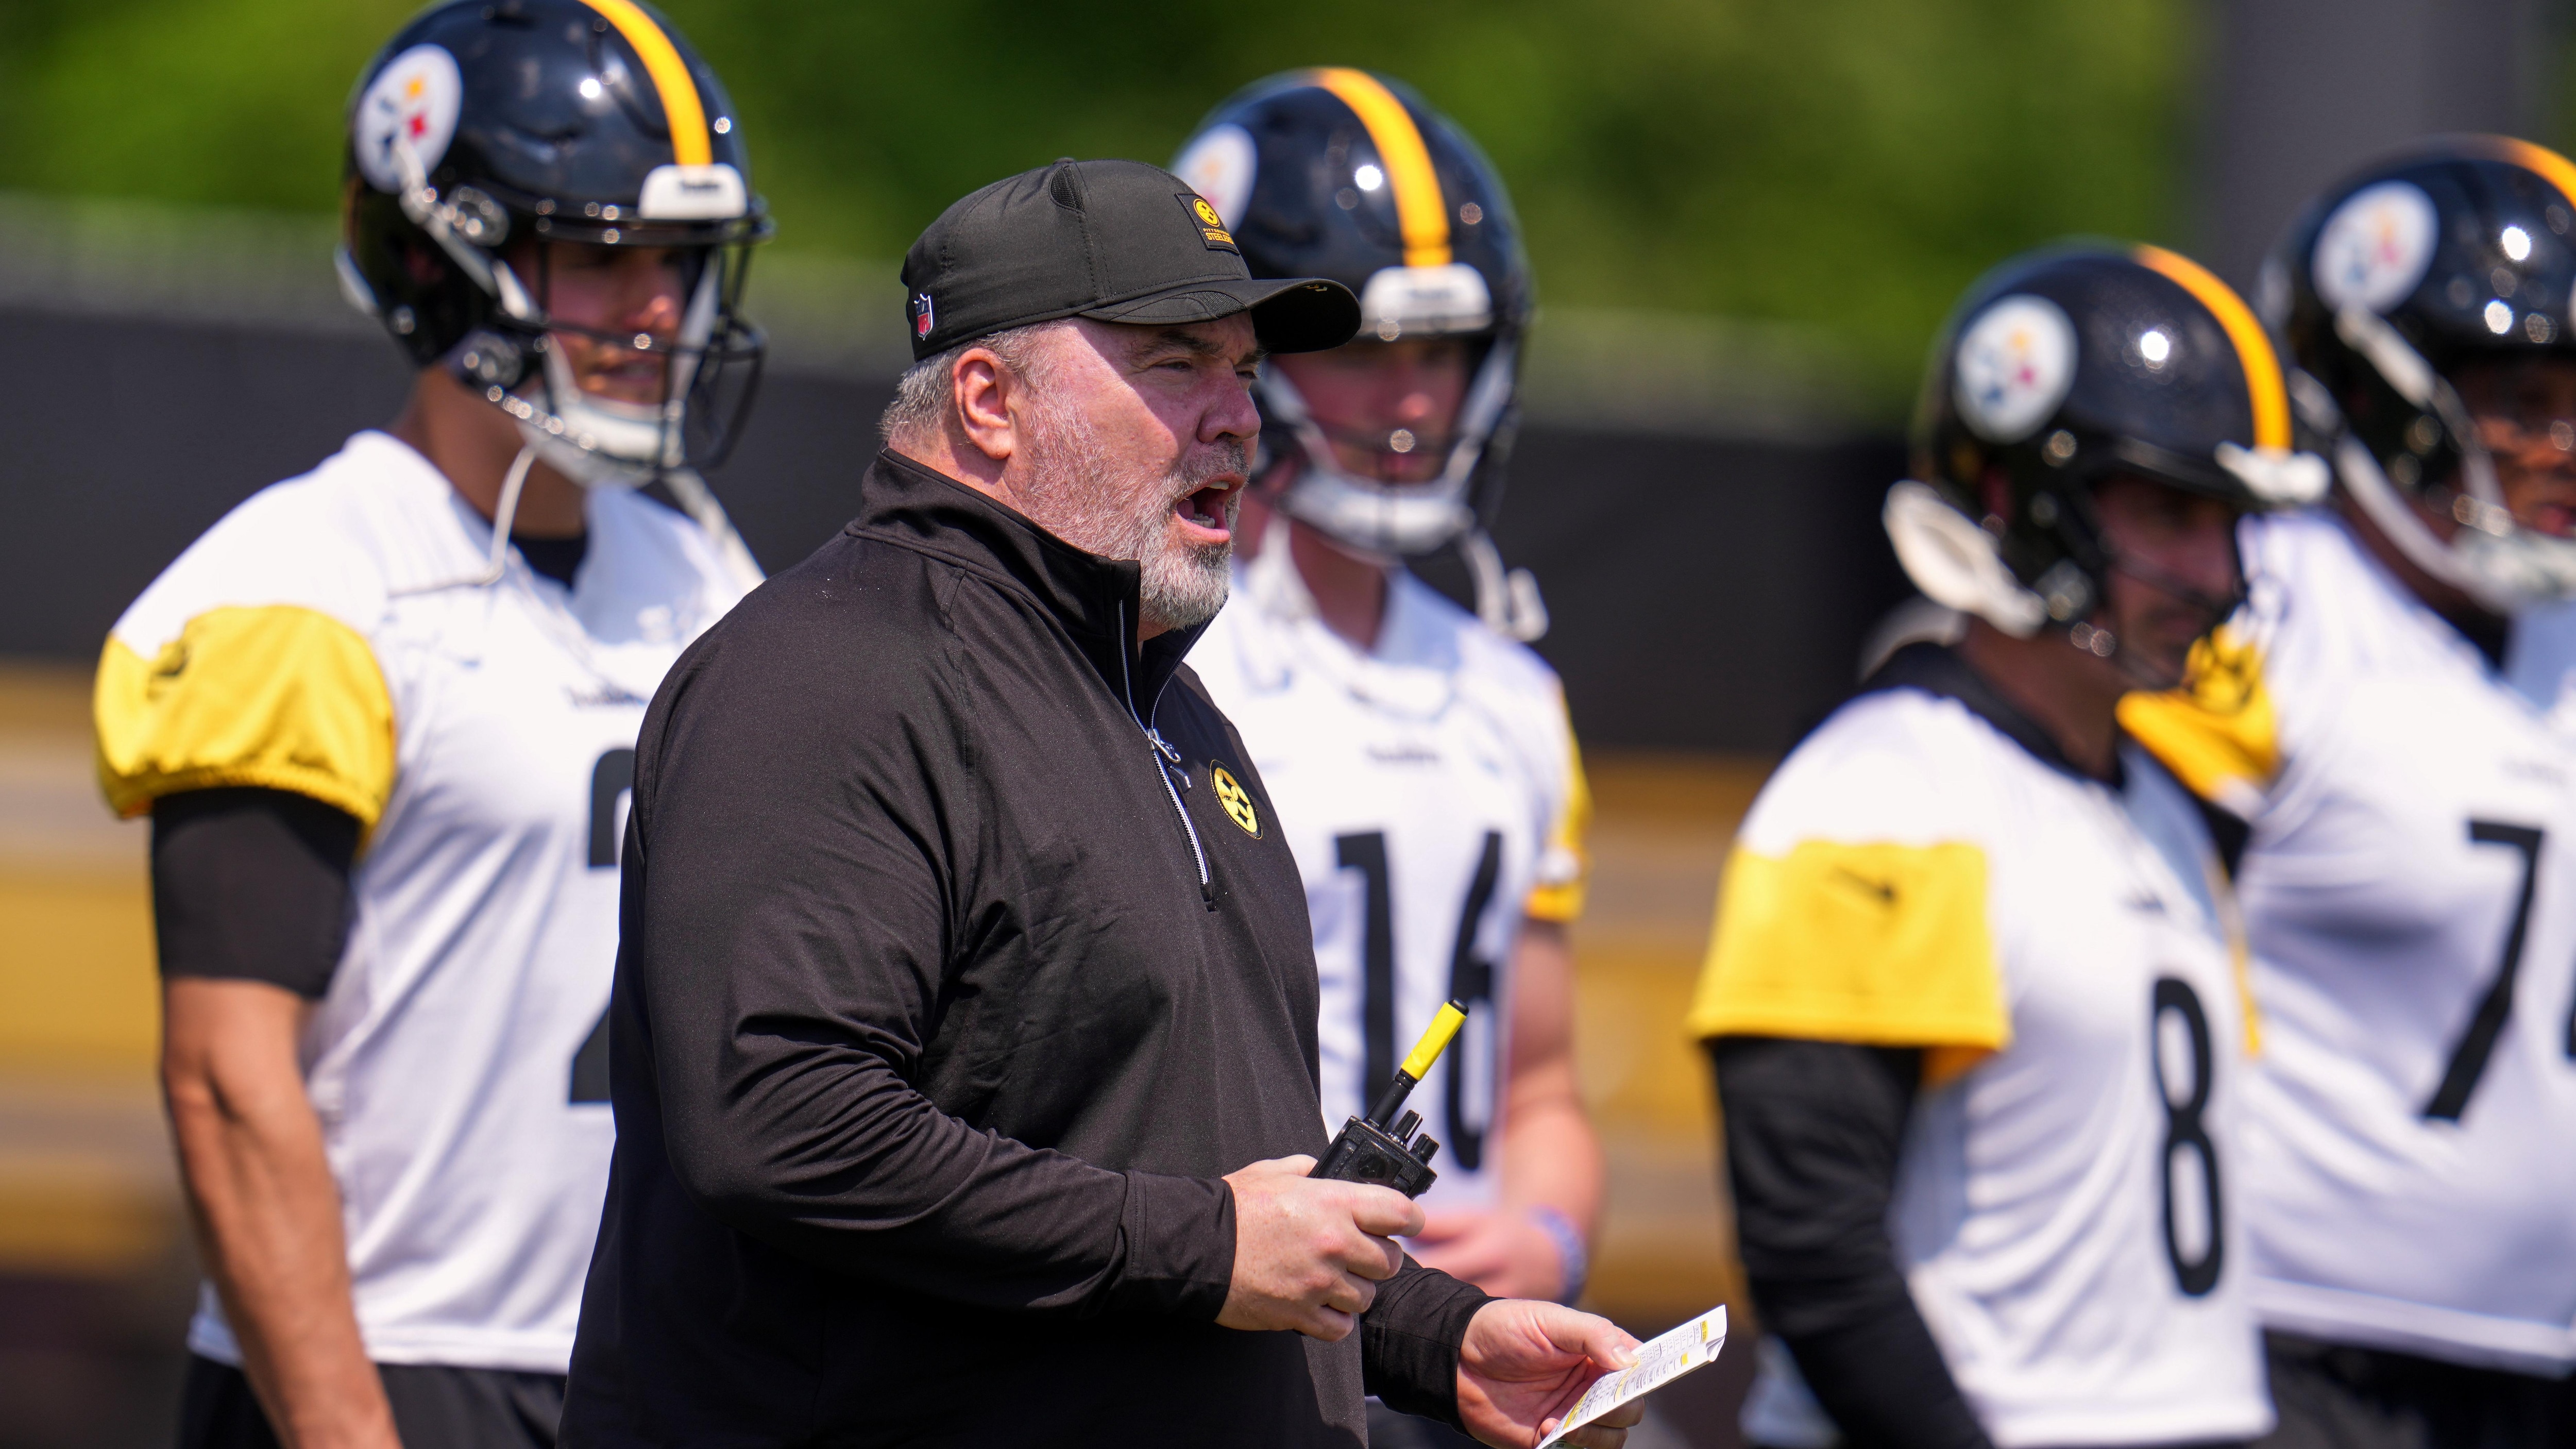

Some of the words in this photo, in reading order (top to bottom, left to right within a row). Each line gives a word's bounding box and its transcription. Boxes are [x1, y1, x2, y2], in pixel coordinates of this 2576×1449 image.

[1202, 228, 1230, 237] PITTSBURGH
[1206, 232, 1234, 245] STEELERS
[1334, 830, 1504, 1171] 16
[2421, 818, 2576, 1121] 7
[2152, 976, 2224, 1297] 8
